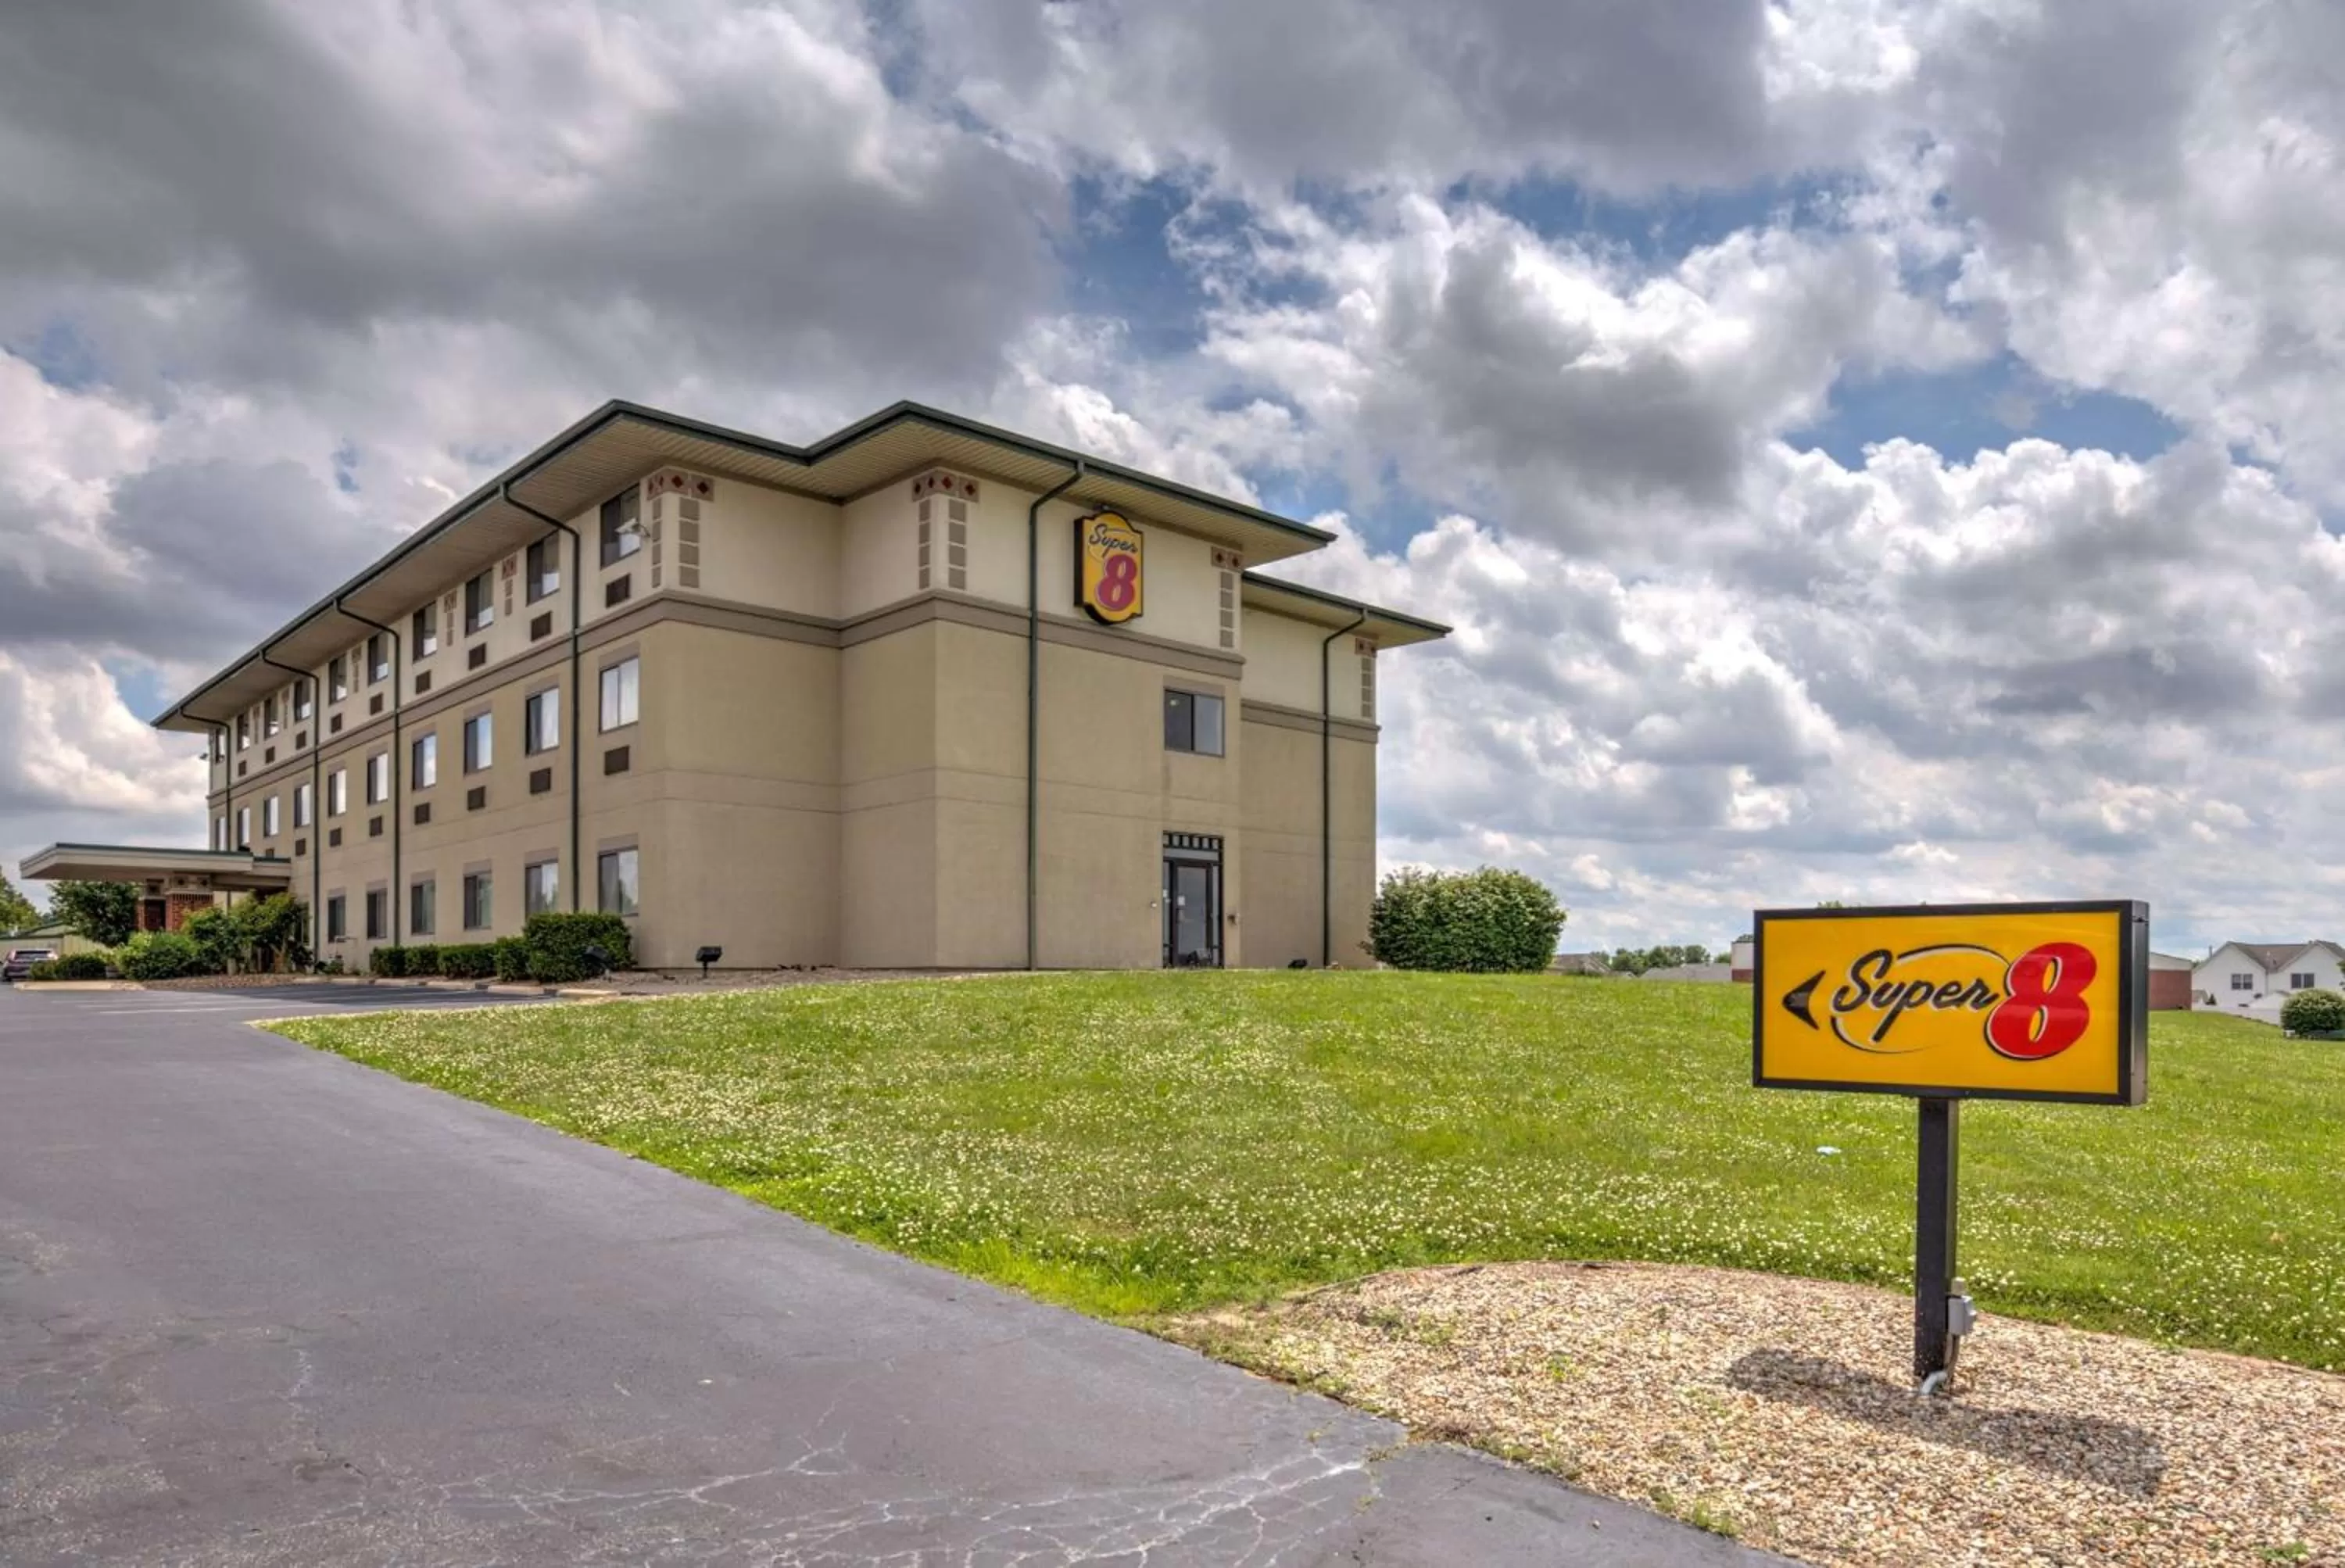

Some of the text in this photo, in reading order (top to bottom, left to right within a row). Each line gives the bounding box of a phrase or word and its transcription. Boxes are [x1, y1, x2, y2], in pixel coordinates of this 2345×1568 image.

[1089, 523, 1138, 559] Super
[1097, 553, 1138, 611] 8
[1831, 942, 2096, 1061] Super 8
